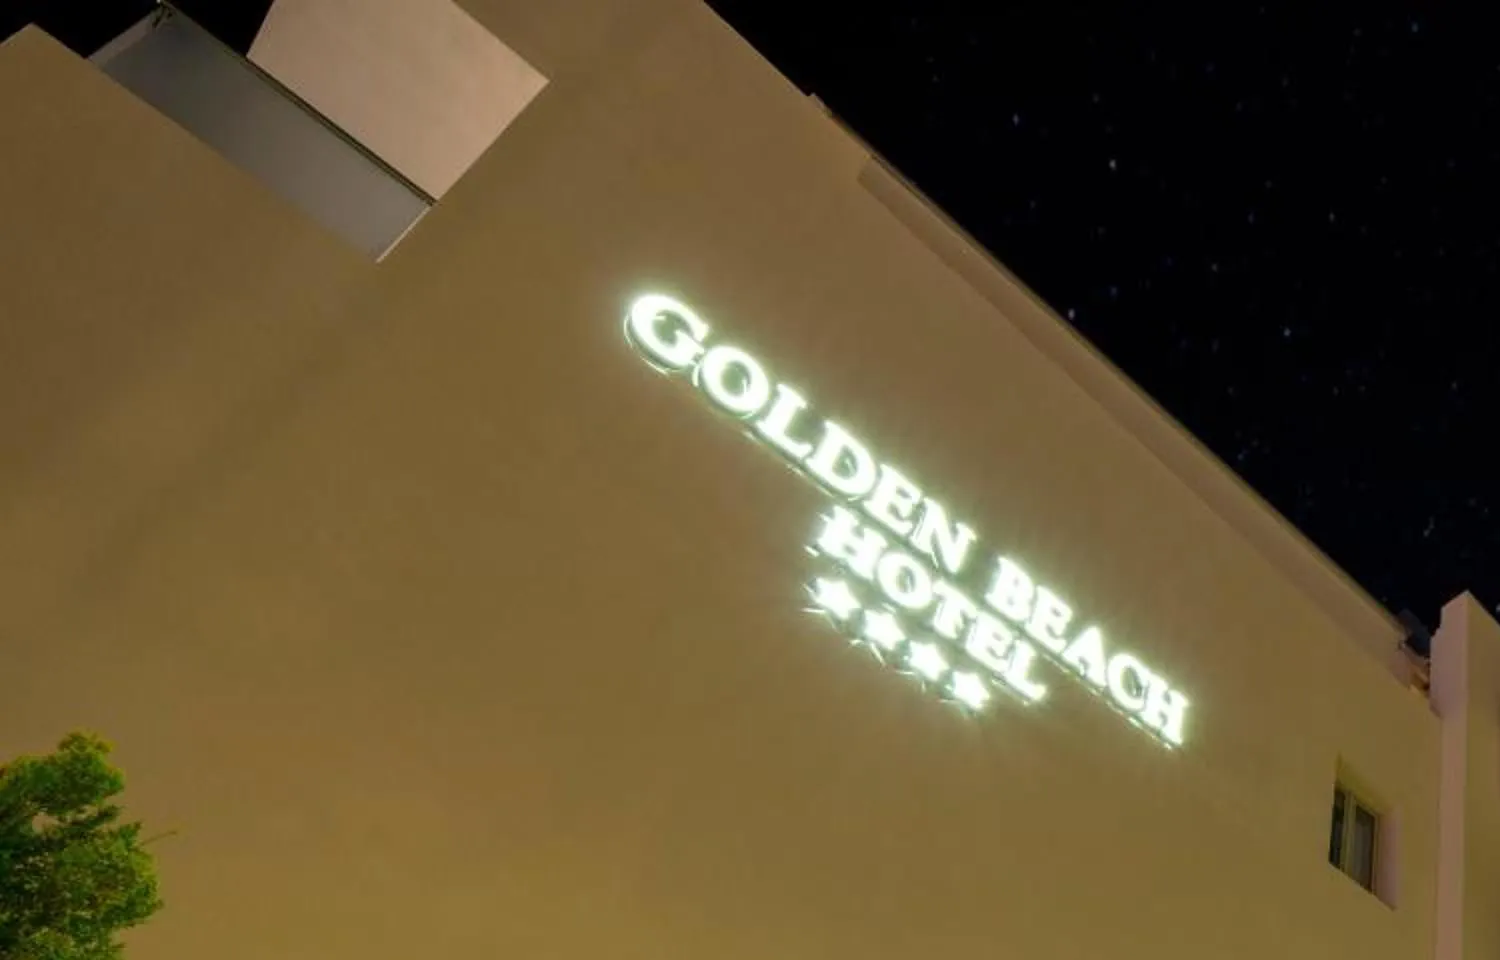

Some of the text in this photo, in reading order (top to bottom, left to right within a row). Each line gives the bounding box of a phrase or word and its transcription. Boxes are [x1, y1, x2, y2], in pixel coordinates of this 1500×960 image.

[626, 293, 1190, 747] GOLDEN BEACH
[813, 504, 1047, 703] HOTEL
